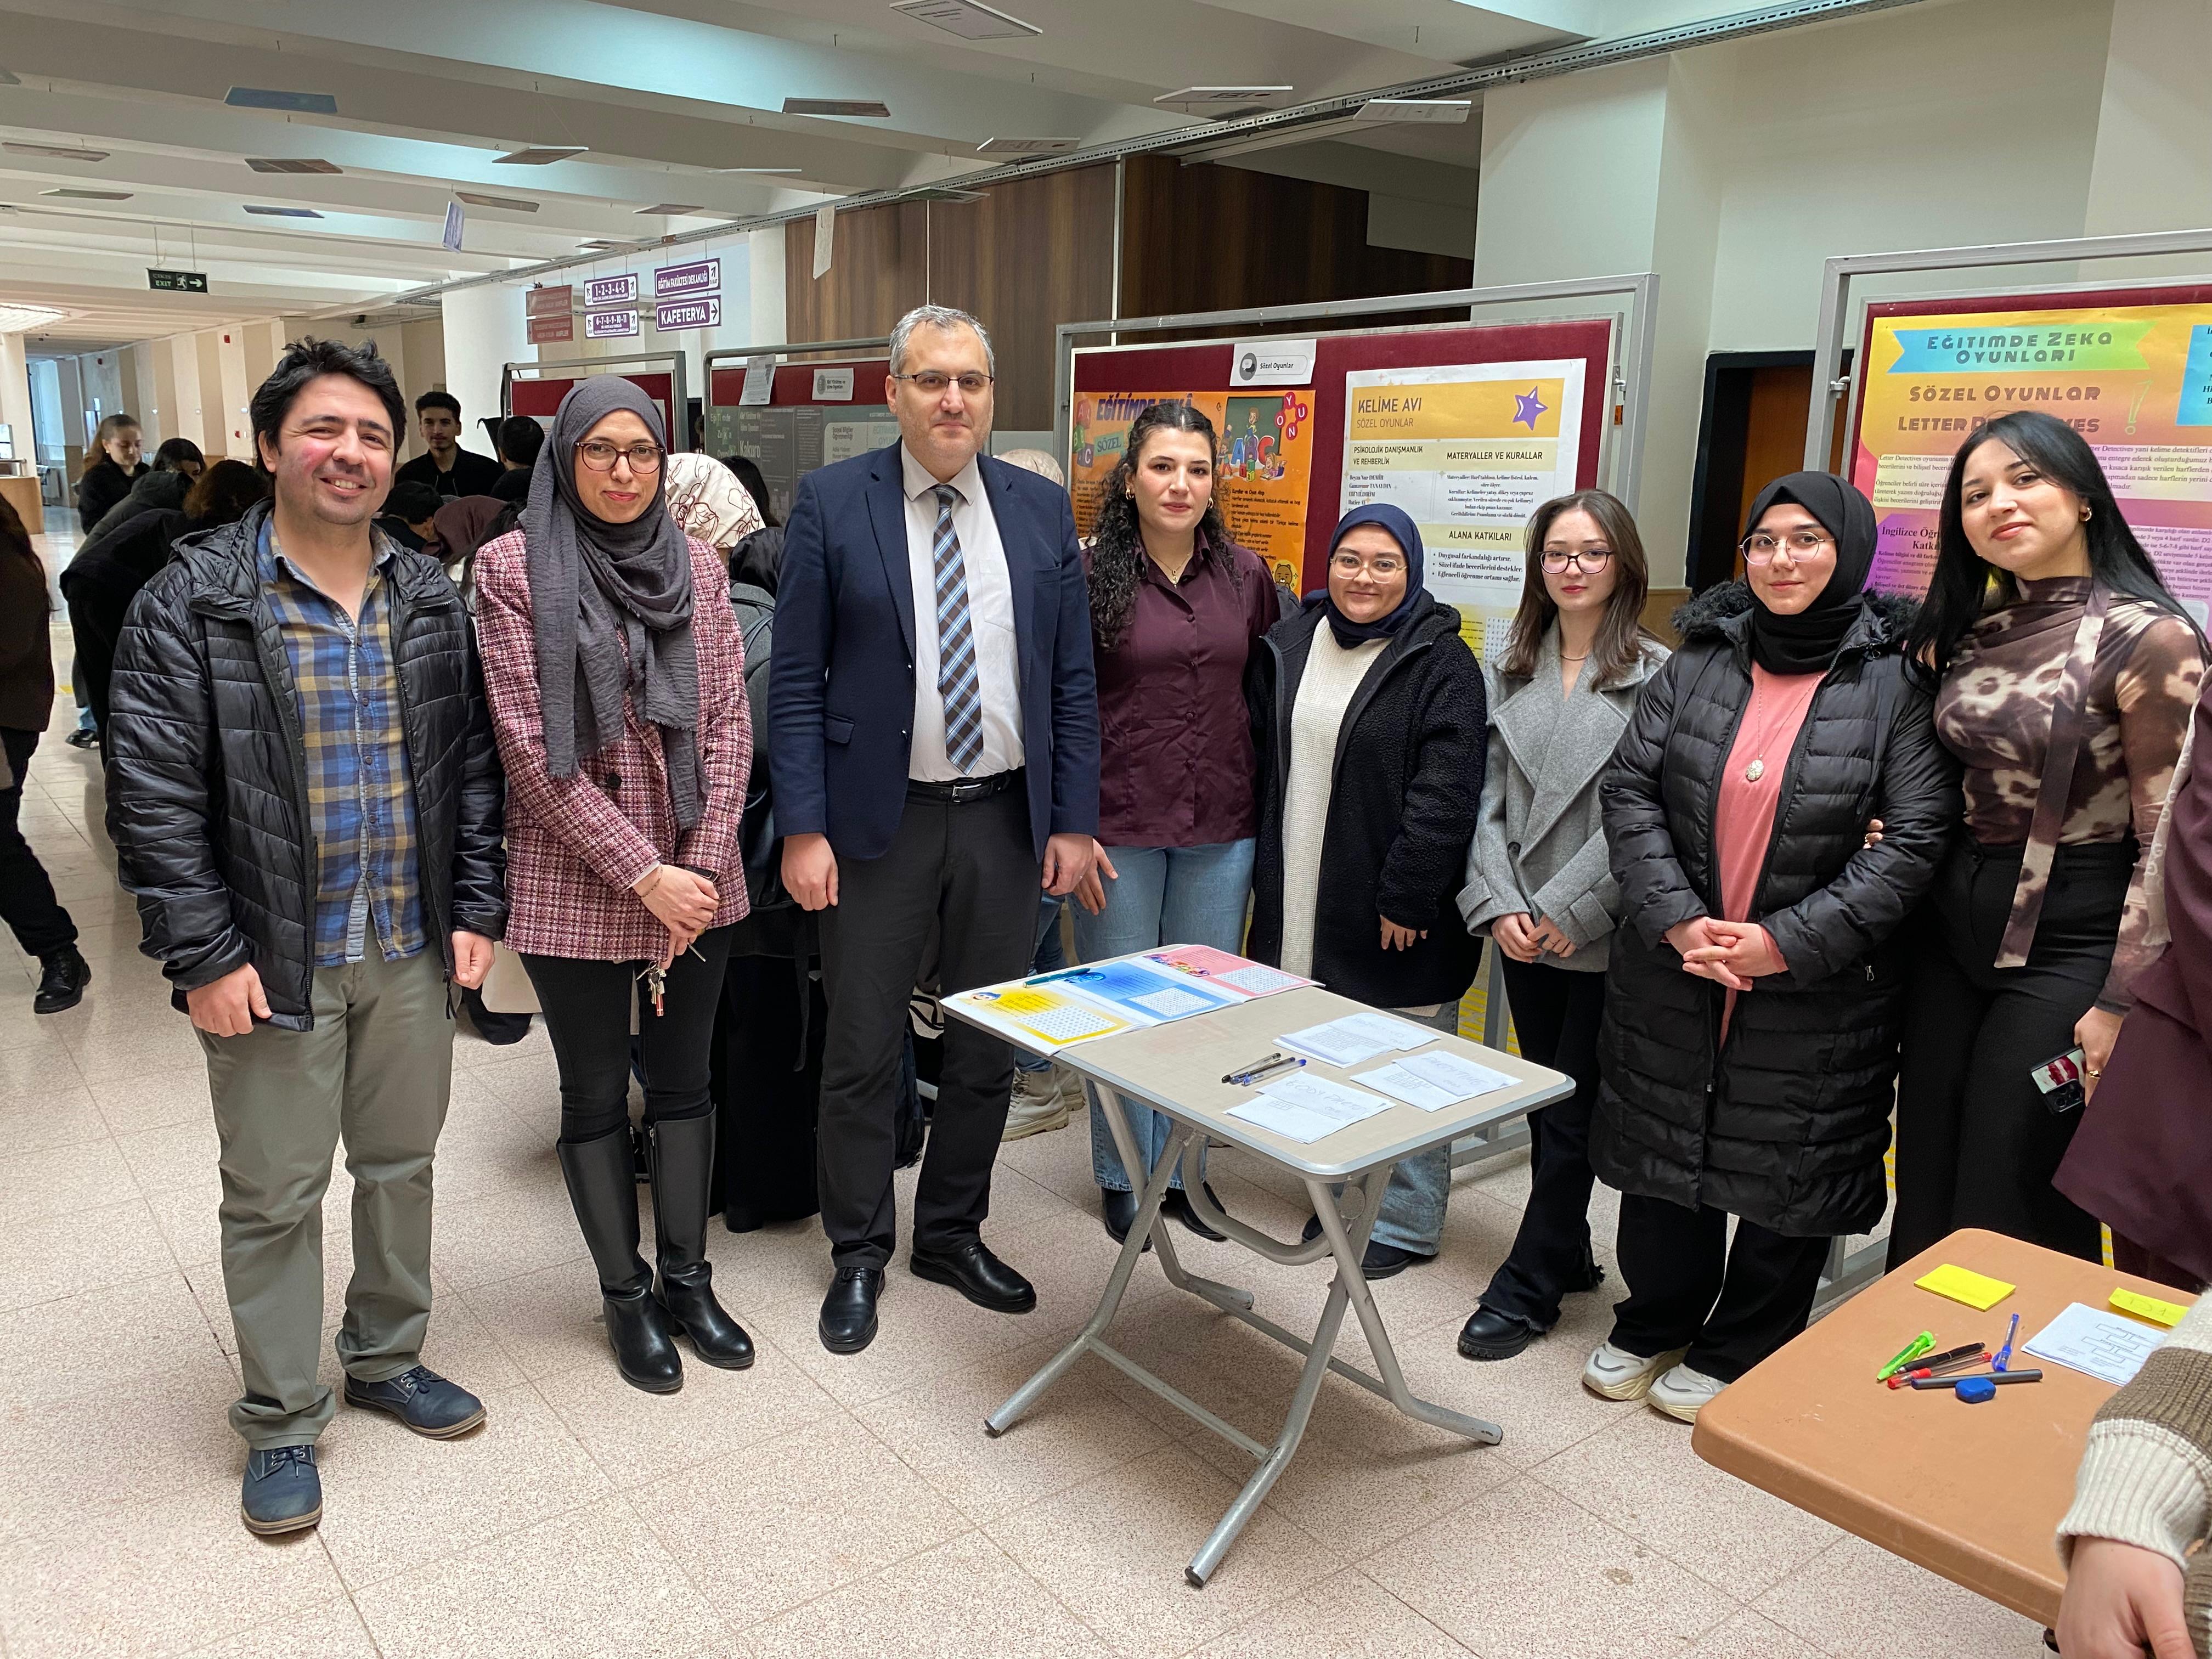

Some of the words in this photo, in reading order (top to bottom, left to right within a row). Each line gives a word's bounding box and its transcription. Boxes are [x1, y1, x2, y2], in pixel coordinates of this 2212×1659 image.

[661, 306, 706, 325] KAFETERYA
[1956, 349, 2076, 364] OYUNLARI
[1273, 363, 1294, 371] Oyunlar
[1909, 385, 1977, 402] SÖZEL
[1984, 385, 2101, 402] OYUNLAR
[1358, 396, 1398, 413] KELİME
[1402, 397, 1421, 412] AVI
[1357, 418, 1377, 428] SÖZEL
[1380, 418, 1413, 427] OYUNLAR
[1898, 416, 1967, 432] LETTER
[740, 441, 760, 458] Kakuro
[1097, 437, 1122, 452] SÖZEL
[1385, 446, 1423, 454] DANIŞMANLIK
[1361, 456, 1389, 465] REHBERLİK
[1449, 531, 1472, 539] ALANA
[1475, 532, 1511, 541] KATKILARI
[1882, 524, 1917, 537] İngilizce
[1462, 553, 1492, 562] farkındalığı
